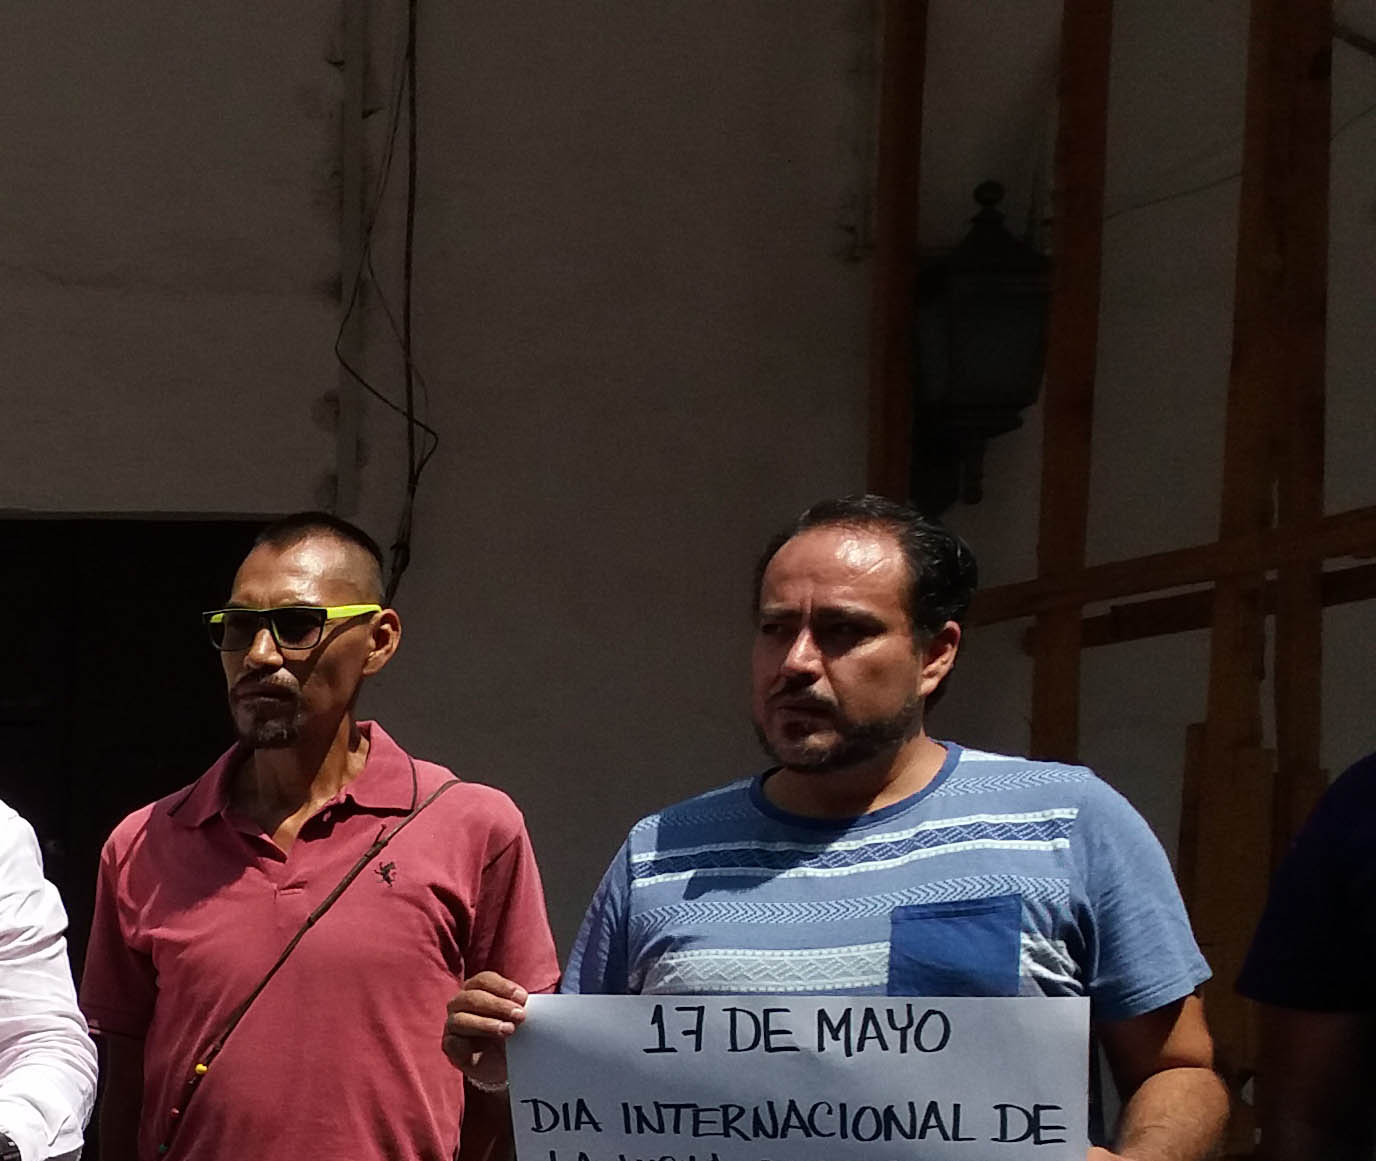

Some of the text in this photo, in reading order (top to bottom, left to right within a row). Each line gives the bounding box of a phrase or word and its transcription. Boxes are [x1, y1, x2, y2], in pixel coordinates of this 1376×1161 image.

[642, 1004, 951, 1057] 17 DE MAYO
[521, 1097, 1067, 1146] DIA INTERNACIONAL DE
